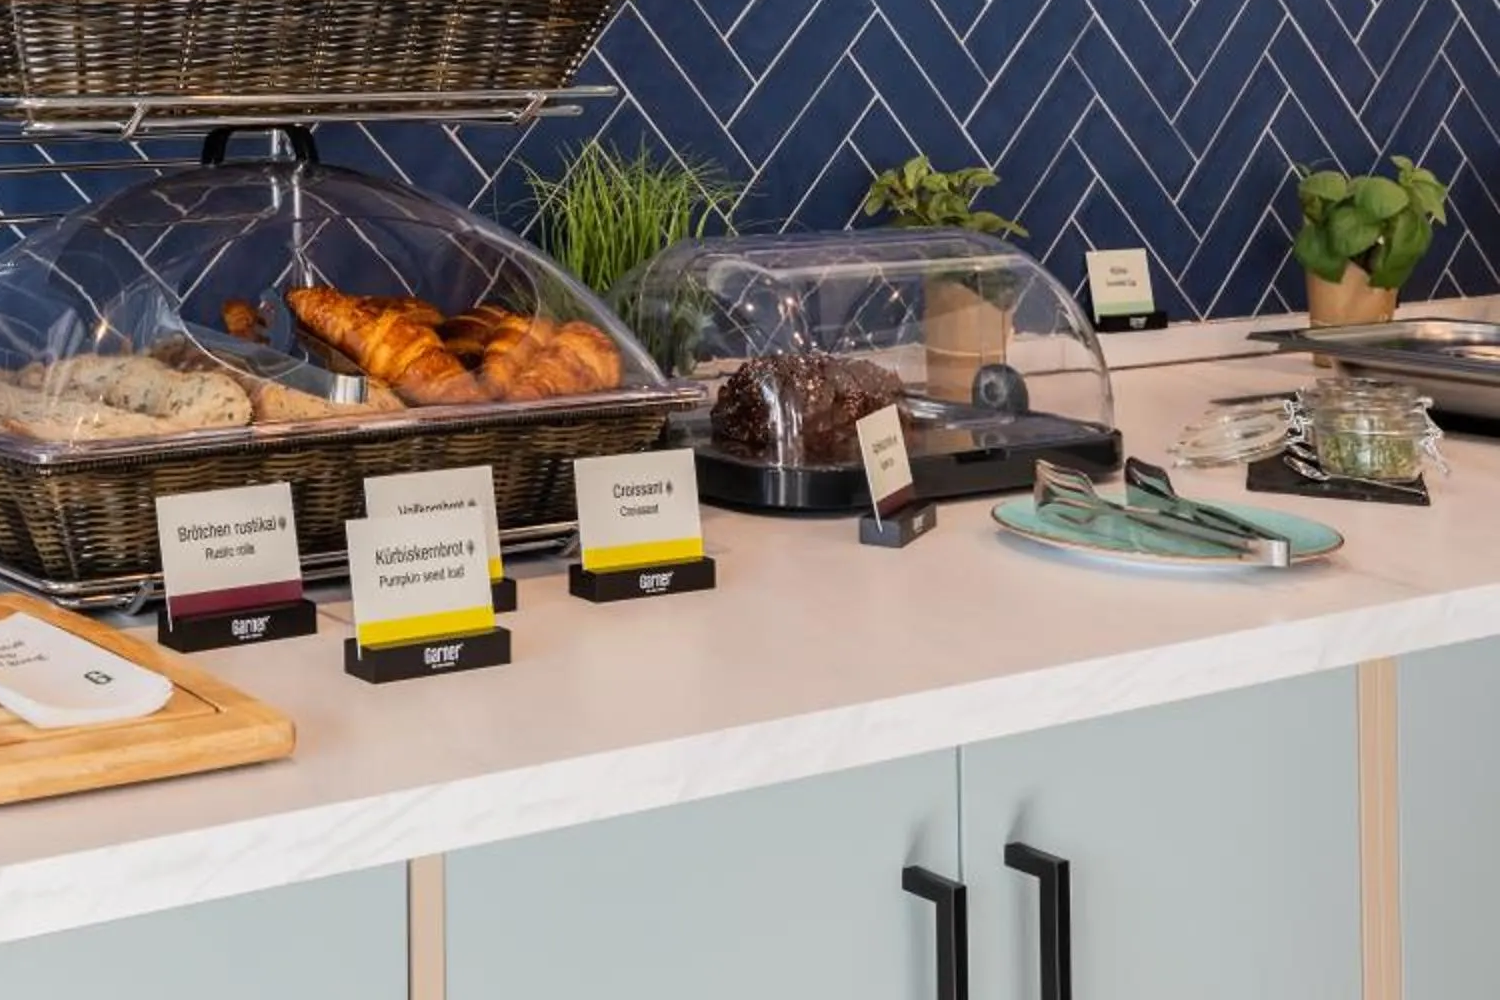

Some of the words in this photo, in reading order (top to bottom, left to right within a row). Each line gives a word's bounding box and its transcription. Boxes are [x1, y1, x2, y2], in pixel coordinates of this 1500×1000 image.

[612, 480, 663, 499] Croissant
[177, 524, 231, 543] Brötchen
[234, 515, 277, 536] rustikal
[375, 540, 464, 566] Kürbiskernbrot
[379, 571, 421, 589] Pumpkin
[639, 571, 674, 590] Garner
[231, 615, 269, 637] Garner
[423, 643, 463, 665] Garner
